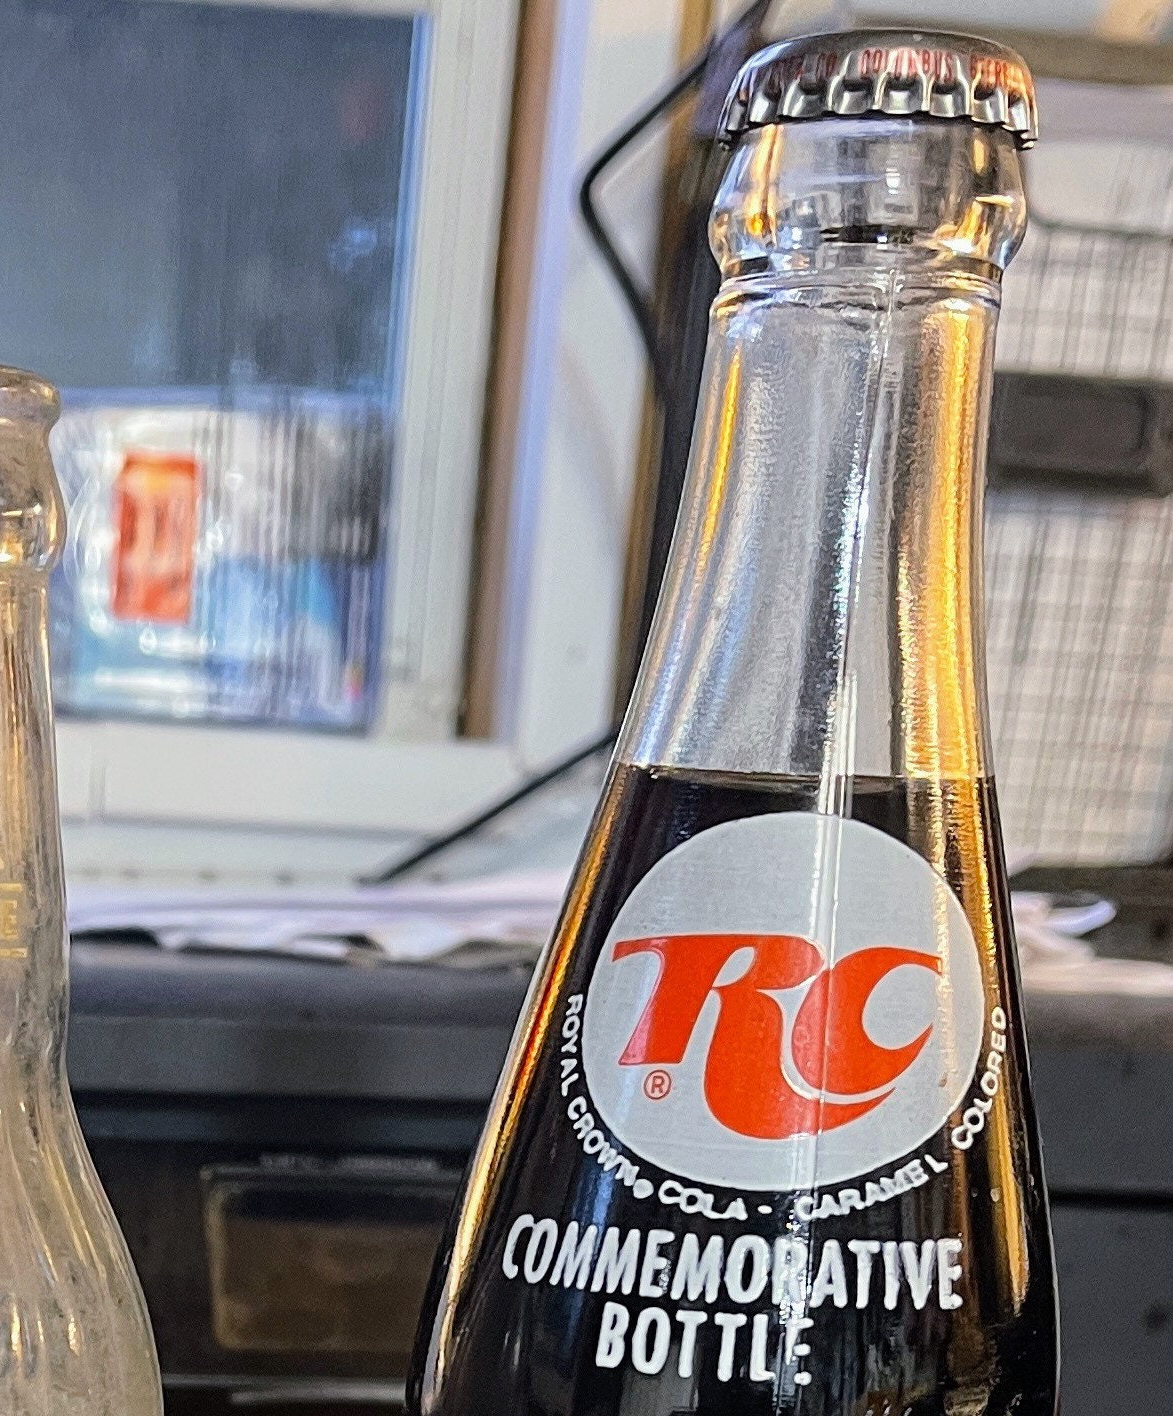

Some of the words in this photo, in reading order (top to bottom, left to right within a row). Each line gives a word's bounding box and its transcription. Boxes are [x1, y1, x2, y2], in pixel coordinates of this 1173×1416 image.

[560, 993, 585, 1097] ROYAL
[658, 1180, 748, 1221] COLA
[794, 1153, 949, 1222] CARAMEL
[951, 1006, 1007, 1151] COLORED
[611, 933, 943, 1140] RC
[502, 1213, 963, 1310] COMMEMORATIVE
[595, 1300, 815, 1386] BOTTLE
